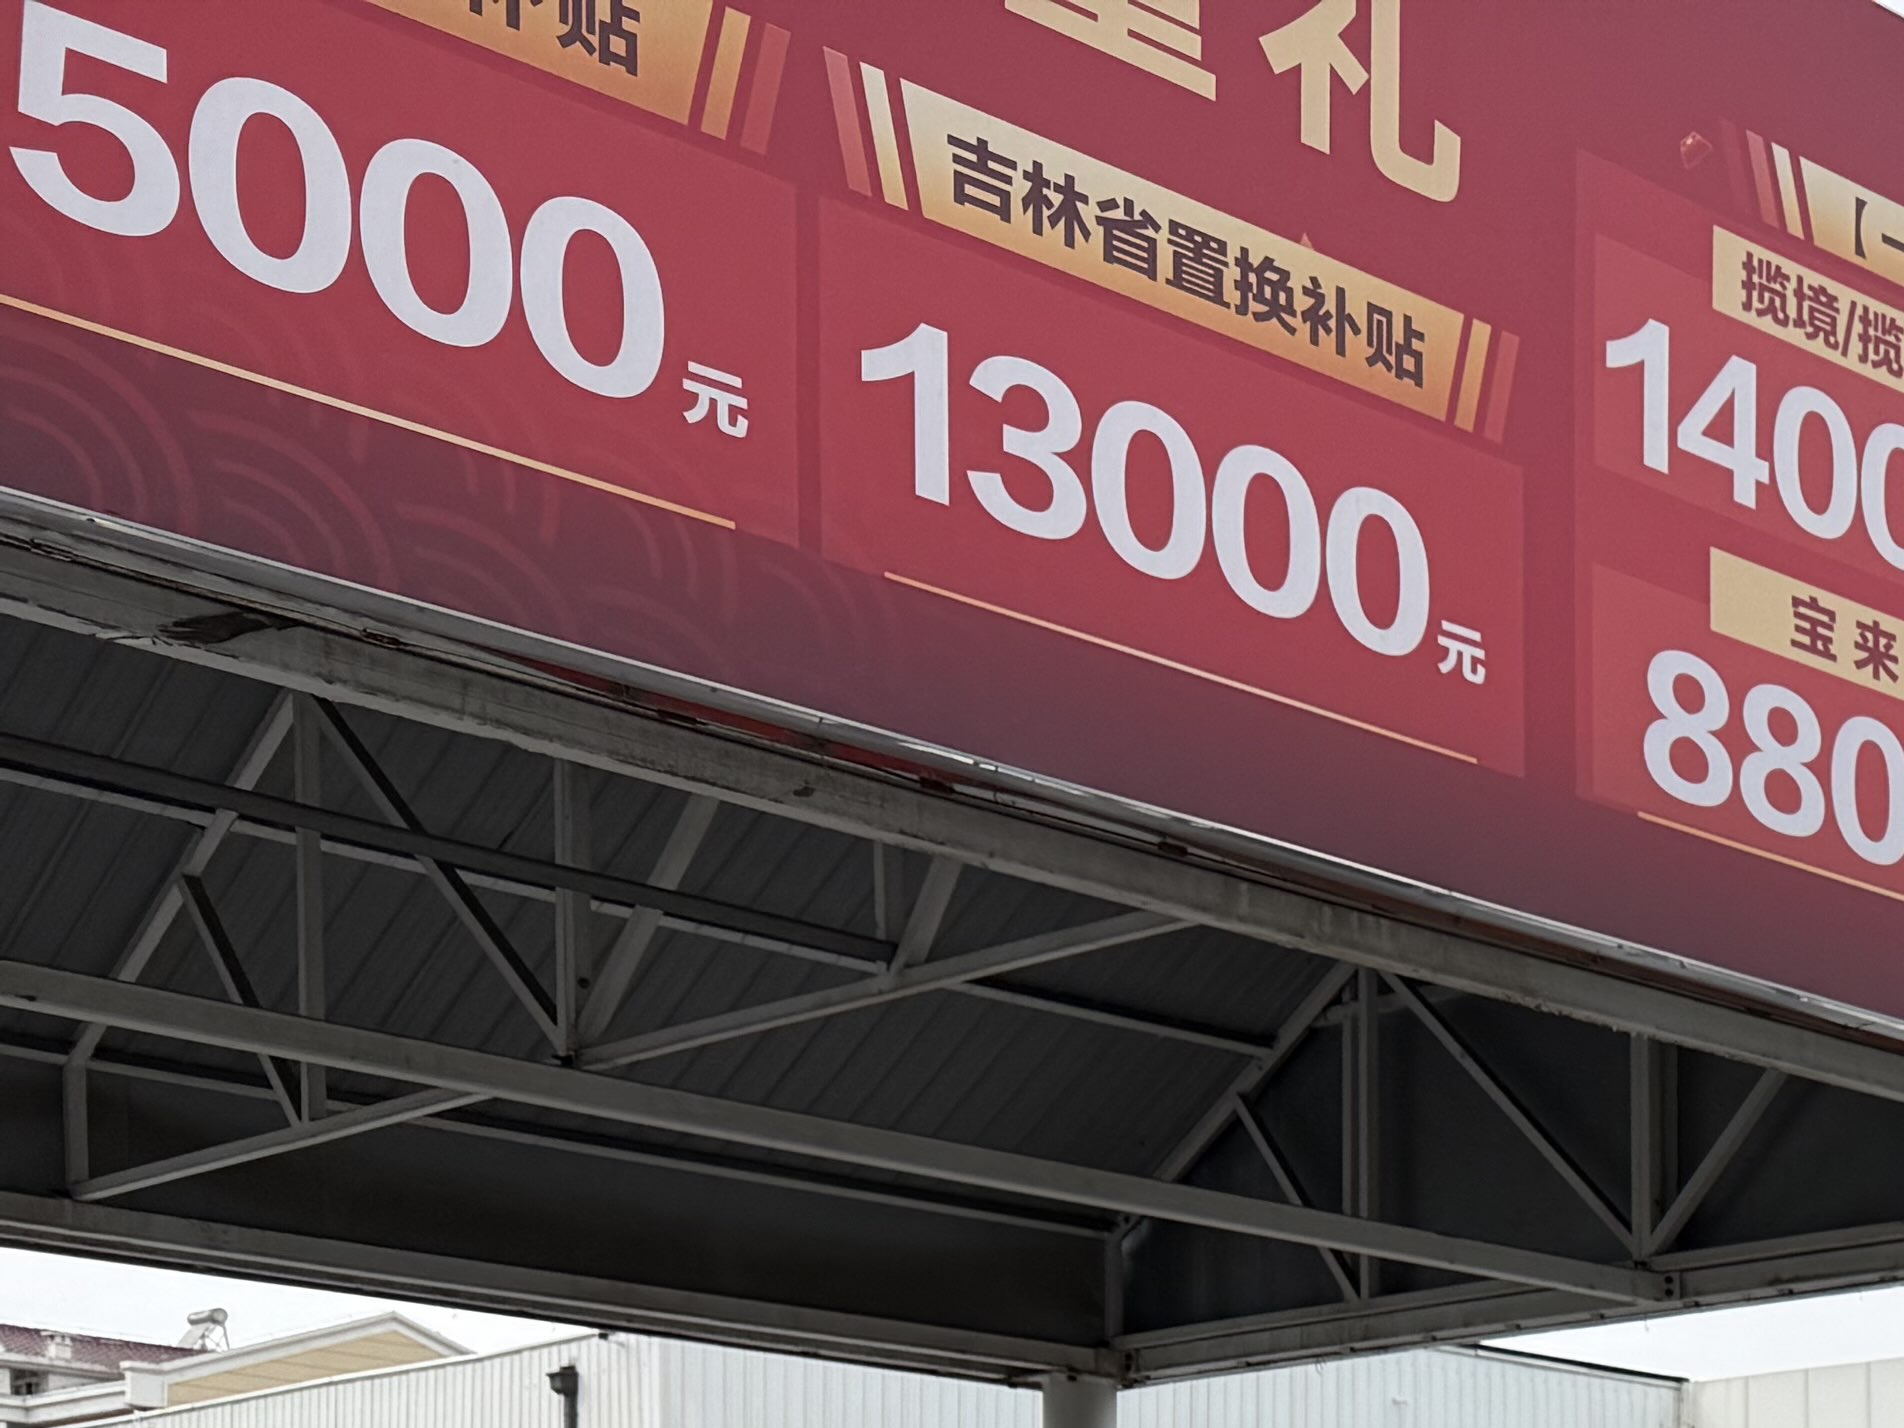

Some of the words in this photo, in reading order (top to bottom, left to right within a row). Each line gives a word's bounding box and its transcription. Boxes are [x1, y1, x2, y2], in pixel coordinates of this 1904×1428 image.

[946, 133, 1425, 389] 吉林省置换补贴
